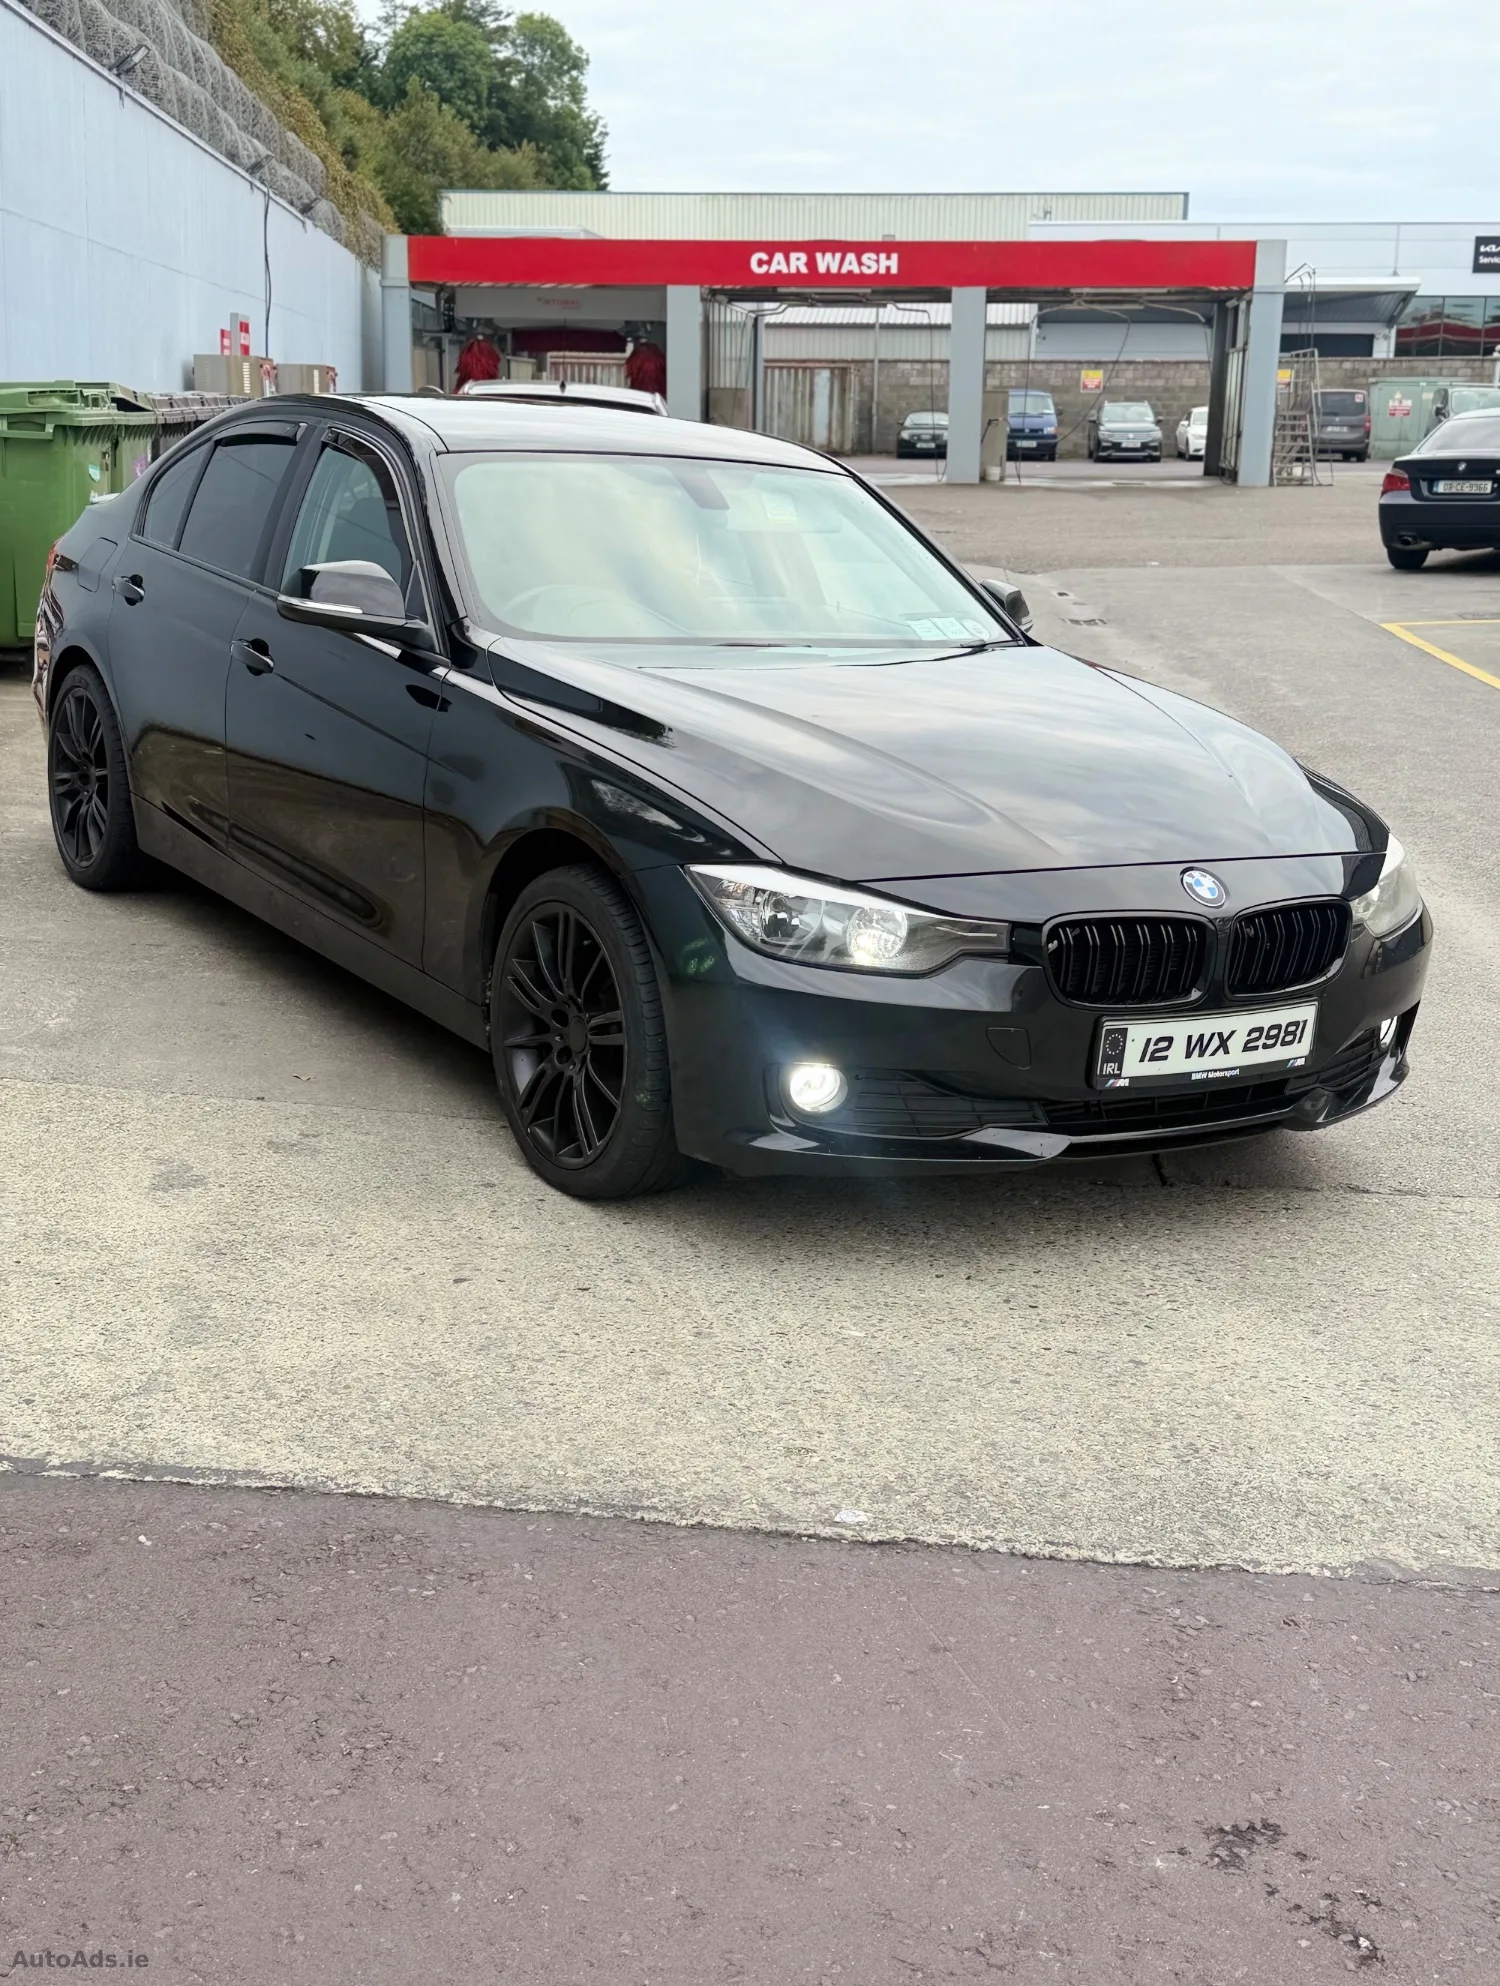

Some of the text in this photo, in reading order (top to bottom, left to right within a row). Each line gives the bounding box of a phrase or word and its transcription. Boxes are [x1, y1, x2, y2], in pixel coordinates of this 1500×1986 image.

[750, 252, 899, 274] CAR WASH
[1139, 1019, 1309, 1063] 12 WX 2981
[1102, 1062, 1121, 1075] IRL
[1191, 1068, 1240, 1080] BMW Motorsport
